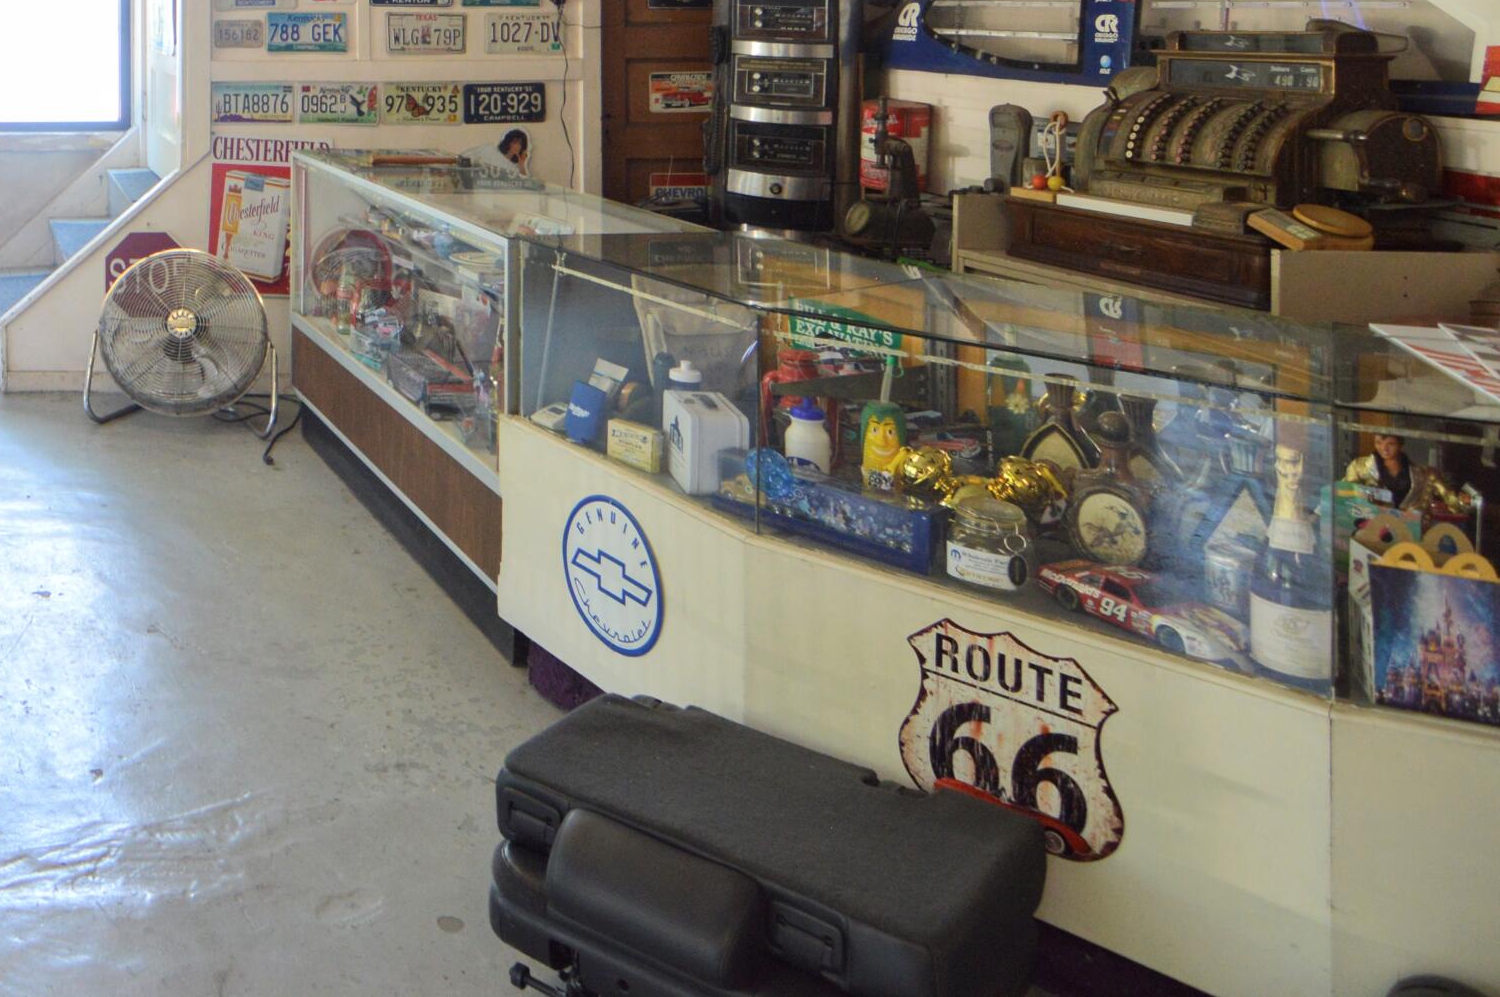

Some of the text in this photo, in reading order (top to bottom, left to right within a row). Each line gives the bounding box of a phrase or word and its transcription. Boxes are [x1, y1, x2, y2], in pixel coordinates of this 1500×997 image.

[270, 23, 342, 42] 788 GEK
[434, 29, 461, 46] 79P
[490, 22, 560, 43] 1027-DV
[223, 94, 289, 114] BTA8876
[301, 95, 338, 114] 0962
[385, 95, 458, 114] 97 935
[470, 93, 542, 116] 120-929
[576, 508, 648, 568] GENUINE
[574, 577, 651, 644] Chevrolet
[1100, 597, 1128, 622] 94
[935, 632, 1083, 716] ROUTE
[929, 702, 1088, 835] 66
